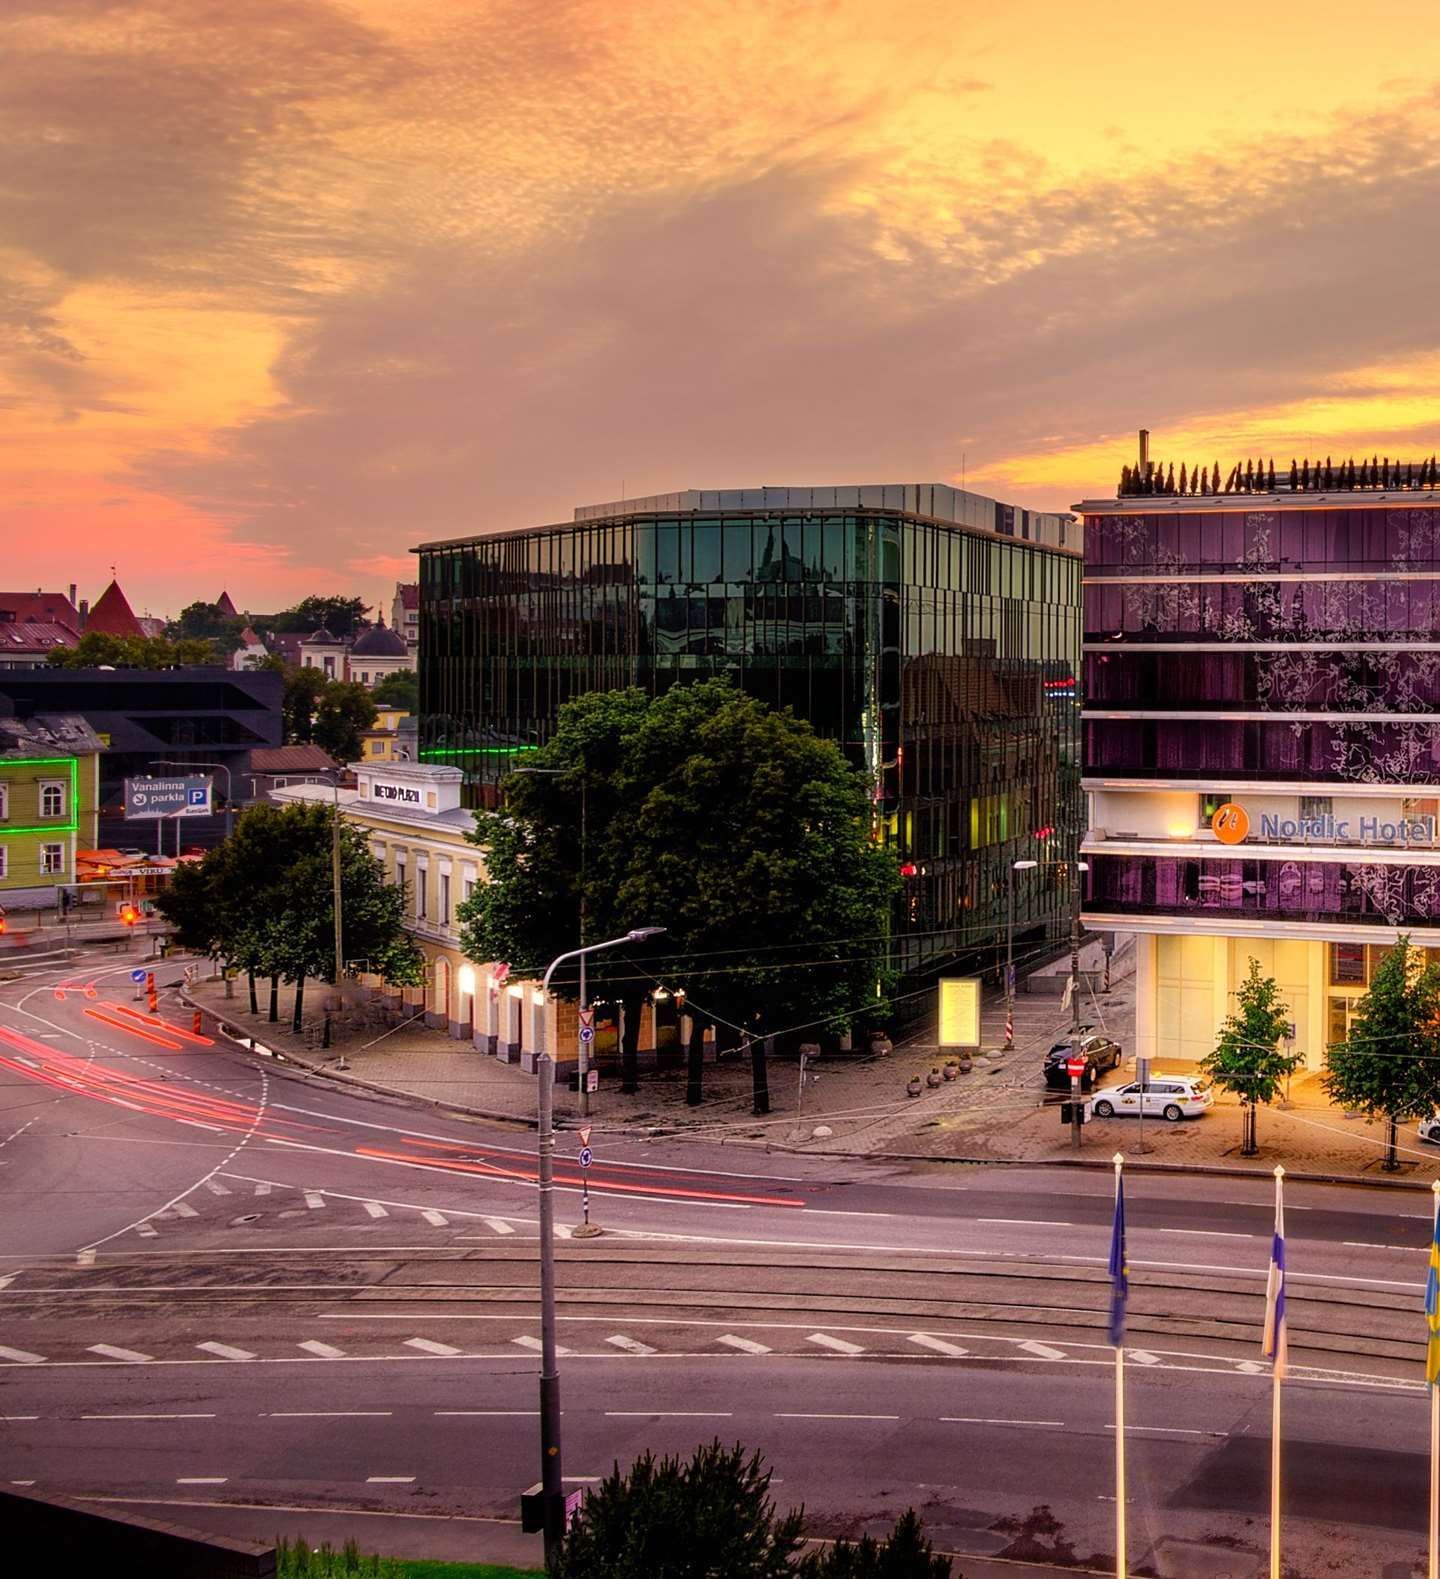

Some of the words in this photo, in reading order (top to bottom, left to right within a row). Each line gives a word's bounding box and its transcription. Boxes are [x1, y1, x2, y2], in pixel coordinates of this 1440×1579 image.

[131, 782, 185, 792] Vanalinna
[151, 793, 185, 805] parkla
[192, 791, 204, 803] P
[1261, 814, 1349, 838] Nordic
[1360, 817, 1434, 842] Hotel
[139, 867, 163, 875] VIRU
